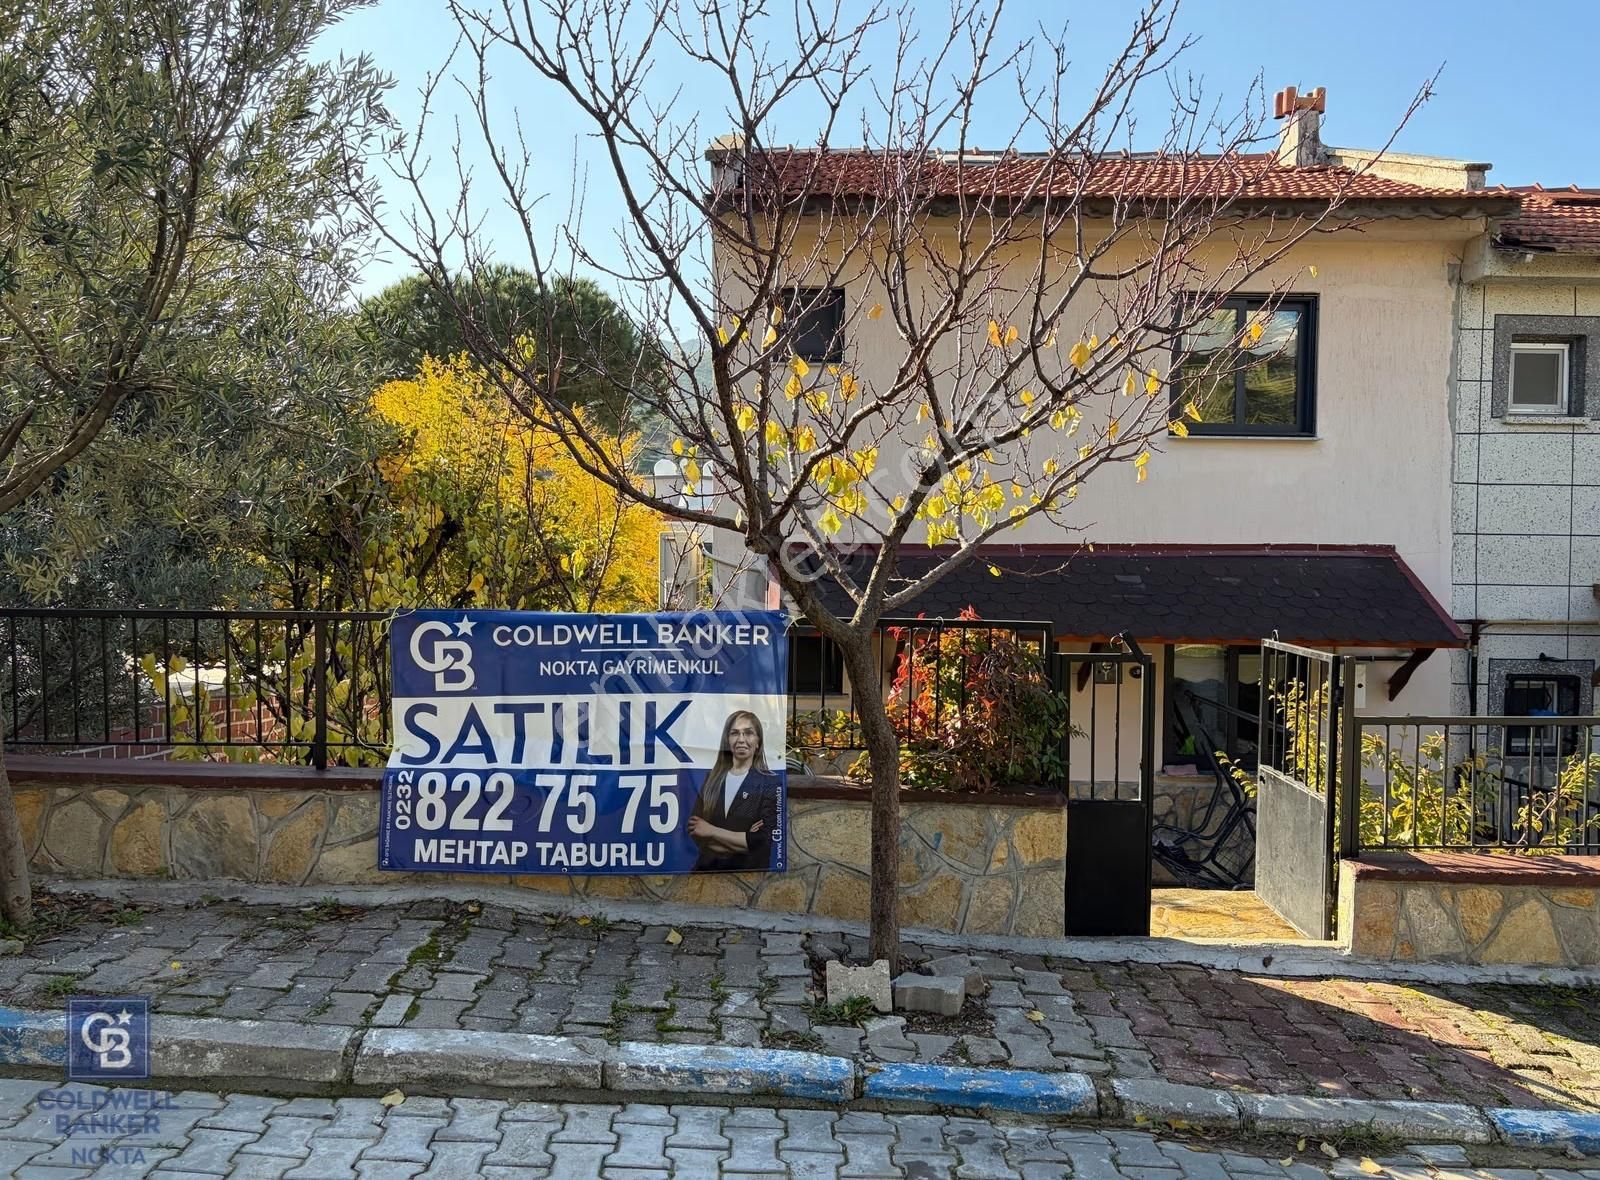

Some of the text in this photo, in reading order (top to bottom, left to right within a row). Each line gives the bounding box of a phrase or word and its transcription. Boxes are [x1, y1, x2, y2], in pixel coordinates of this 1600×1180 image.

[409, 621, 475, 692] CB
[492, 623, 770, 647] COLDWELL BANKER
[540, 656, 724, 676] NOKTA GAYRİMENKUL
[399, 700, 694, 766] SATILIK
[395, 770, 415, 830] 0232
[415, 771, 515, 832] 822
[535, 774, 597, 834] 75
[618, 774, 680, 834] 75
[413, 838, 665, 868] MEHTAP TABURLU
